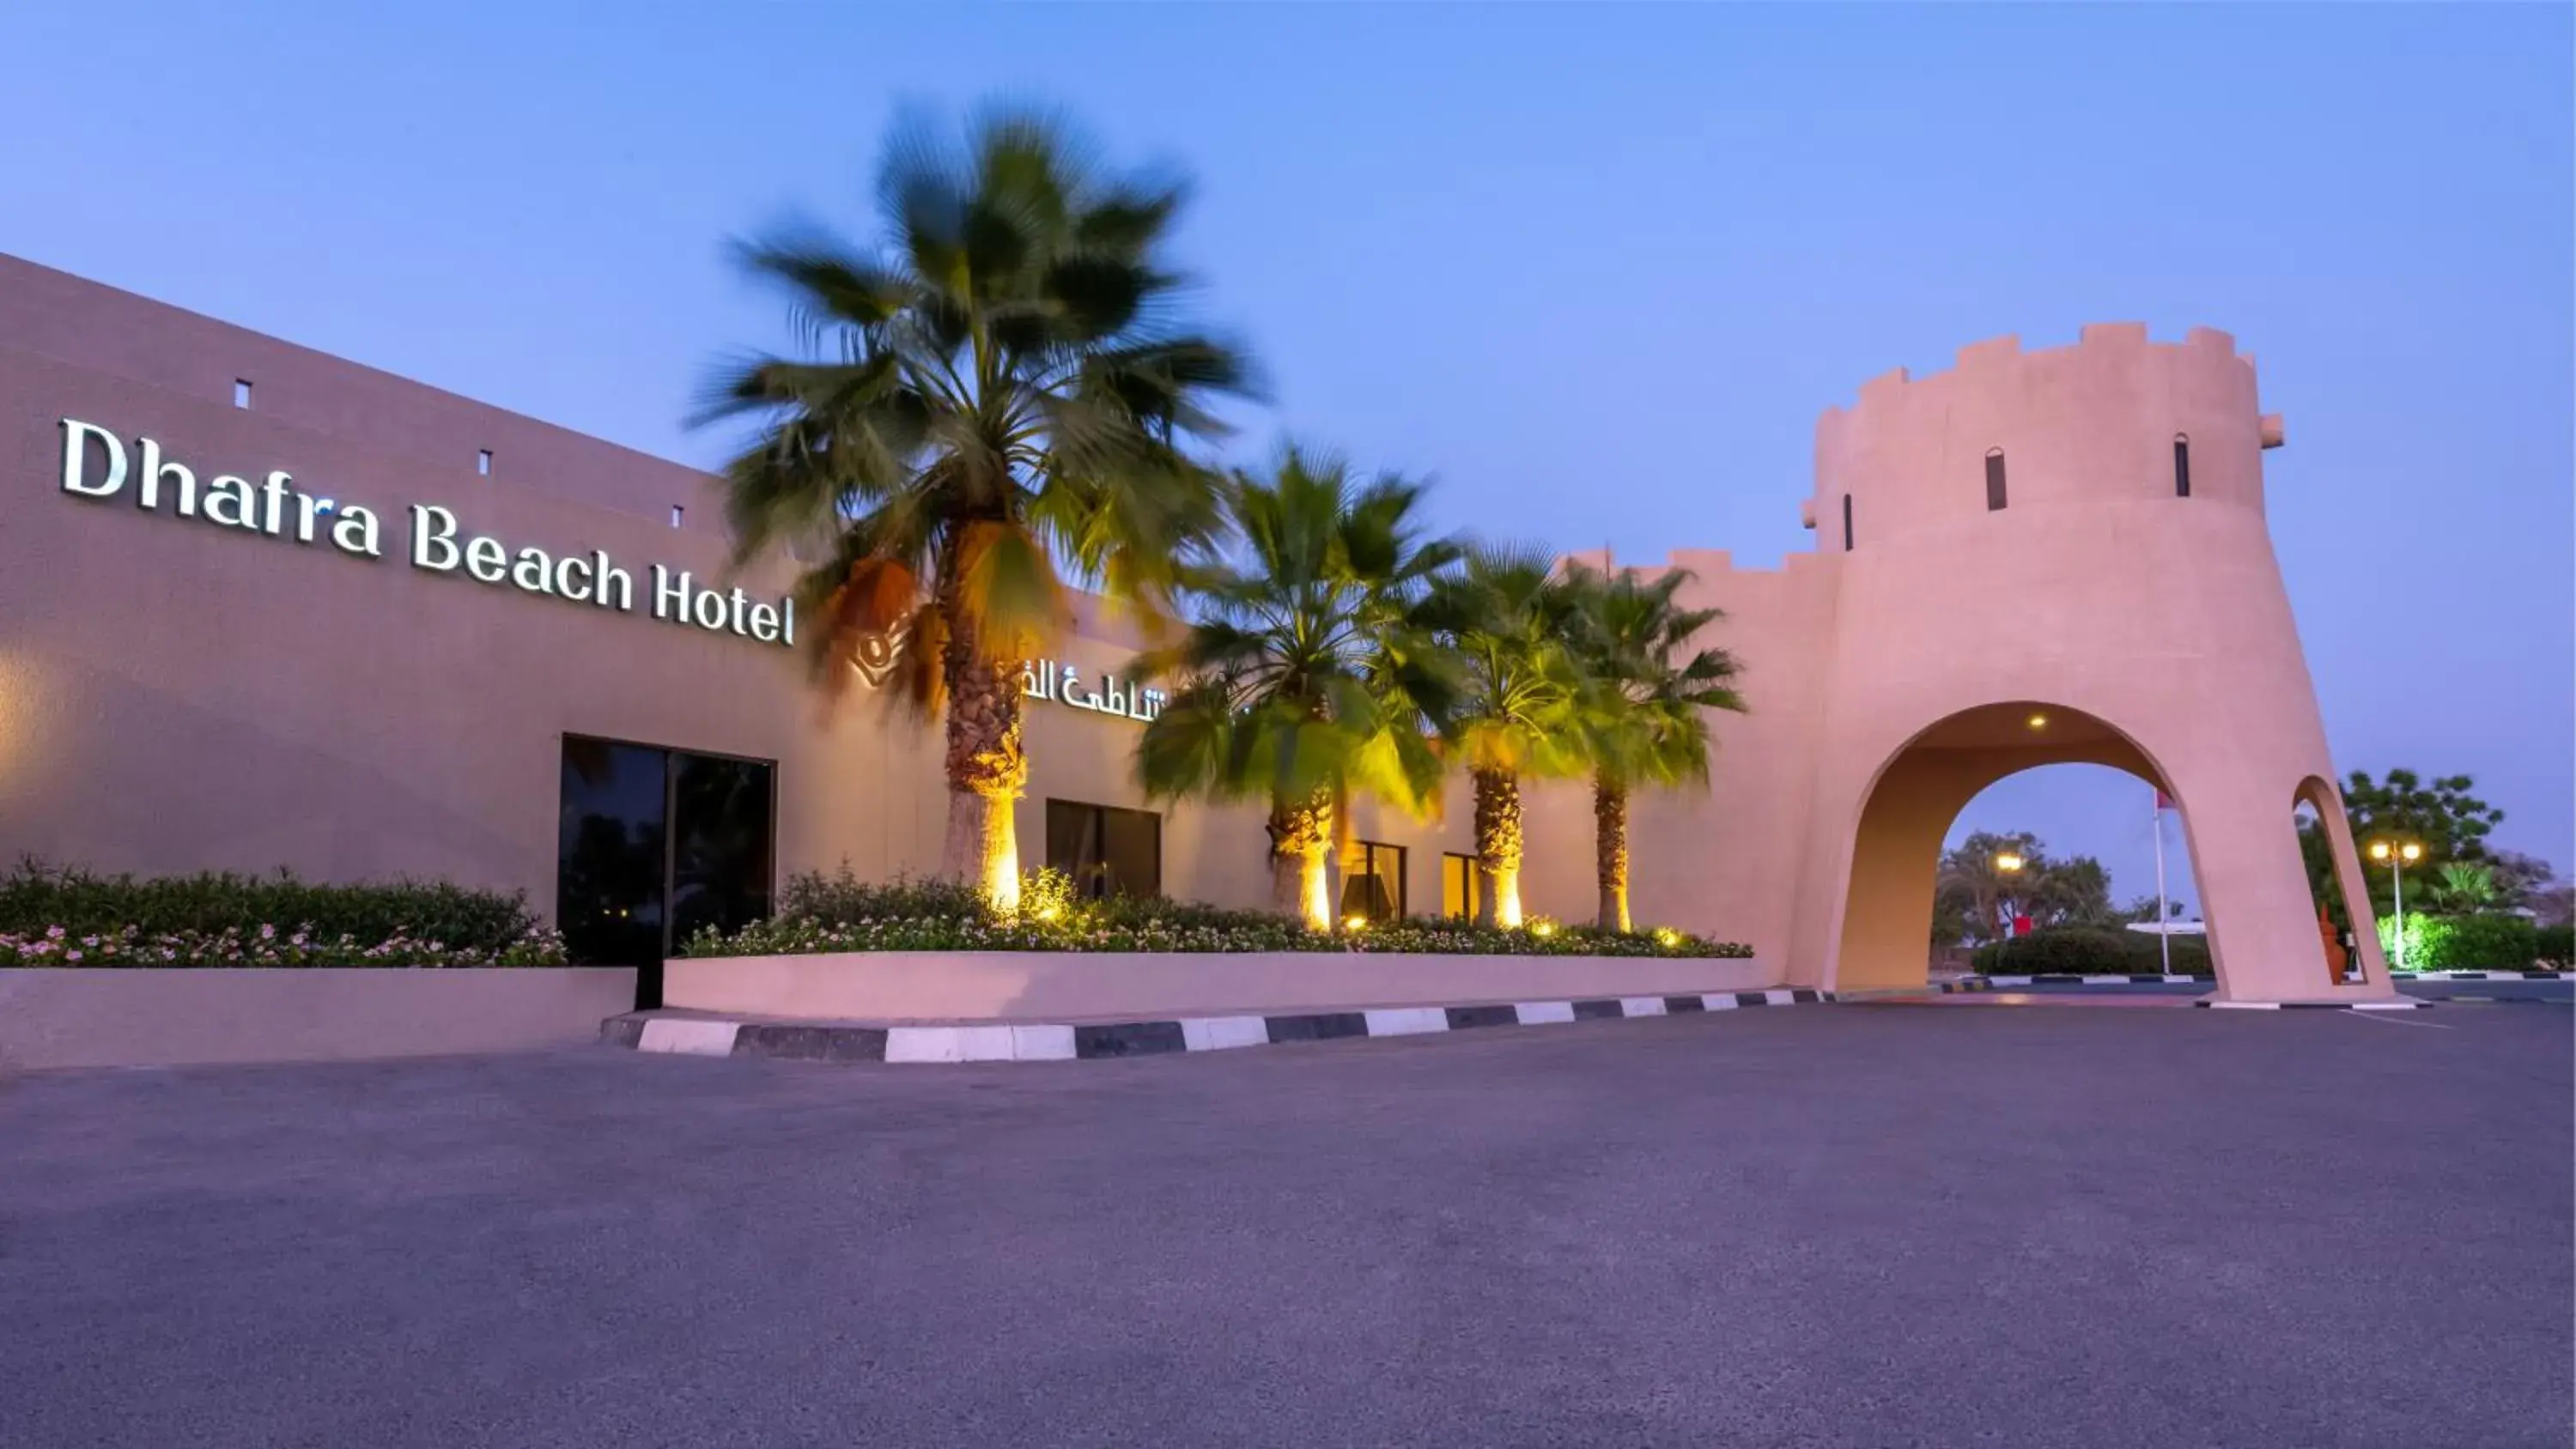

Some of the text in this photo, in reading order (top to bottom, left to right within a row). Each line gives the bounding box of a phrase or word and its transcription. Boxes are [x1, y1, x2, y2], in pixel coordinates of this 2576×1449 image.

[60, 417, 795, 646] Dhafra Beach Hotel
